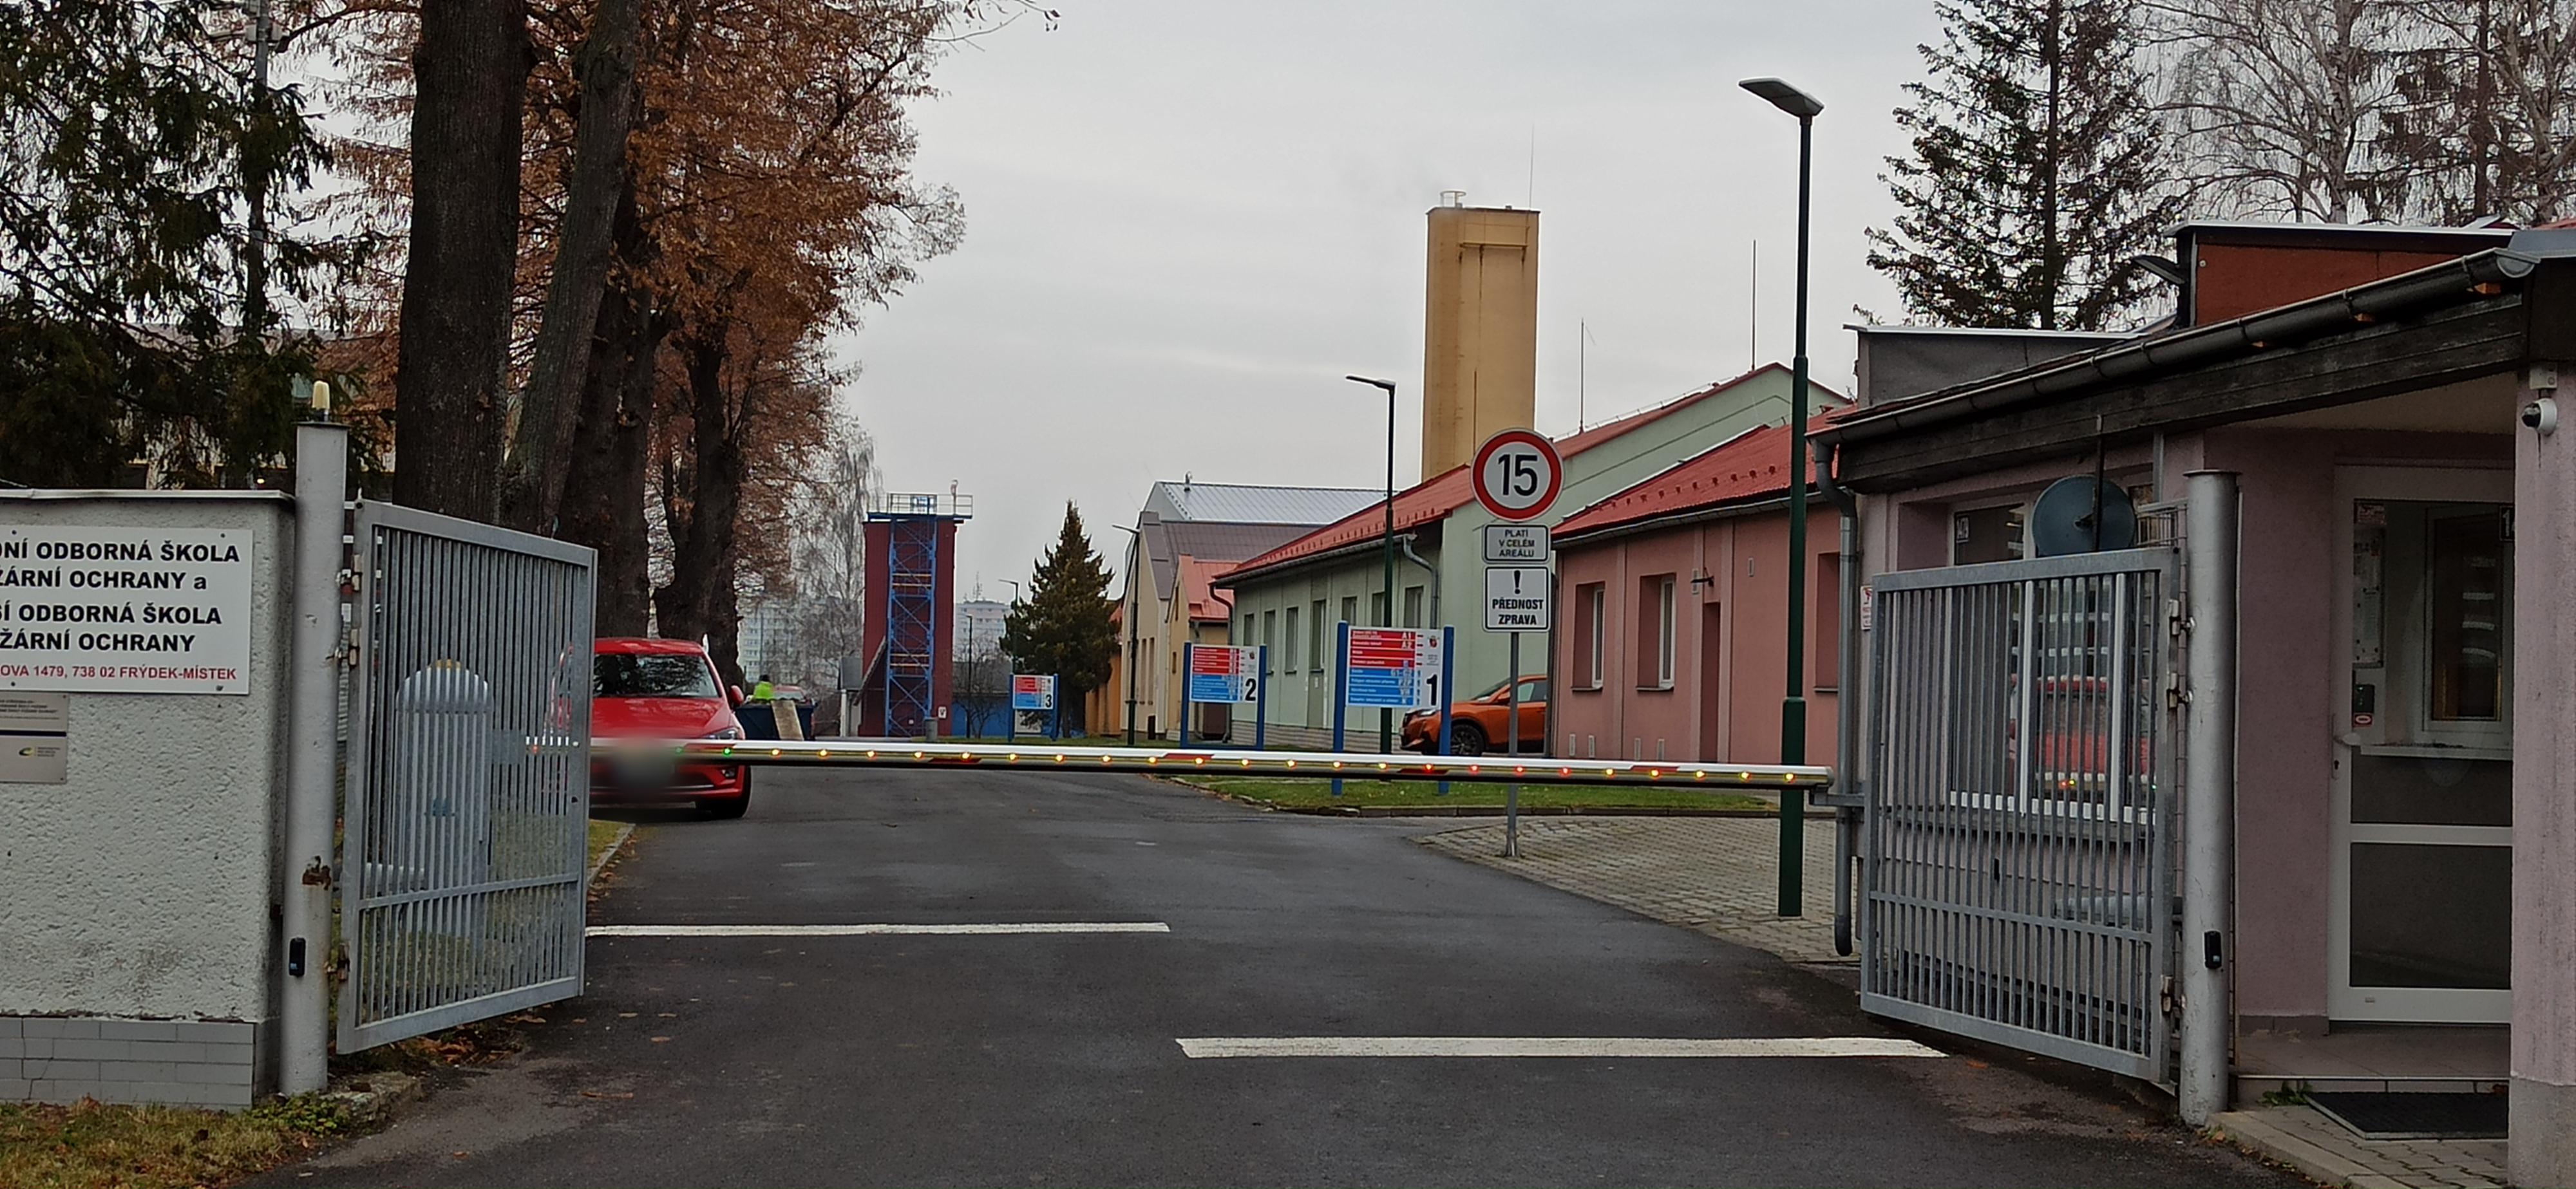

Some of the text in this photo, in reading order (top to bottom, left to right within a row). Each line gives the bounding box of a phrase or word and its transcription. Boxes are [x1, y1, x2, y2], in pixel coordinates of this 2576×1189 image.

[1498, 454, 1538, 496] 15
[0, 538, 240, 562] NÍ ODBORNÁ ŠKOLA
[1506, 538, 1535, 547] CELÉM
[69, 570, 186, 590] OCHRANY
[193, 576, 207, 590] a
[19, 601, 135, 624] ODBORNÁ
[142, 602, 222, 624] ŠKOLA
[1492, 597, 1544, 610] PŘEDNOST
[1498, 614, 1537, 625] ZPRAVA
[78, 633, 195, 652] OCHRANY
[34, 666, 67, 679] 1479,
[73, 666, 95, 677] 738
[100, 666, 115, 678] 02
[120, 664, 236, 680] FRÝDEK-MÍSTEK
[1245, 678, 1256, 701] 2
[1426, 674, 1438, 706] 1
[1045, 694, 1052, 708] 3
